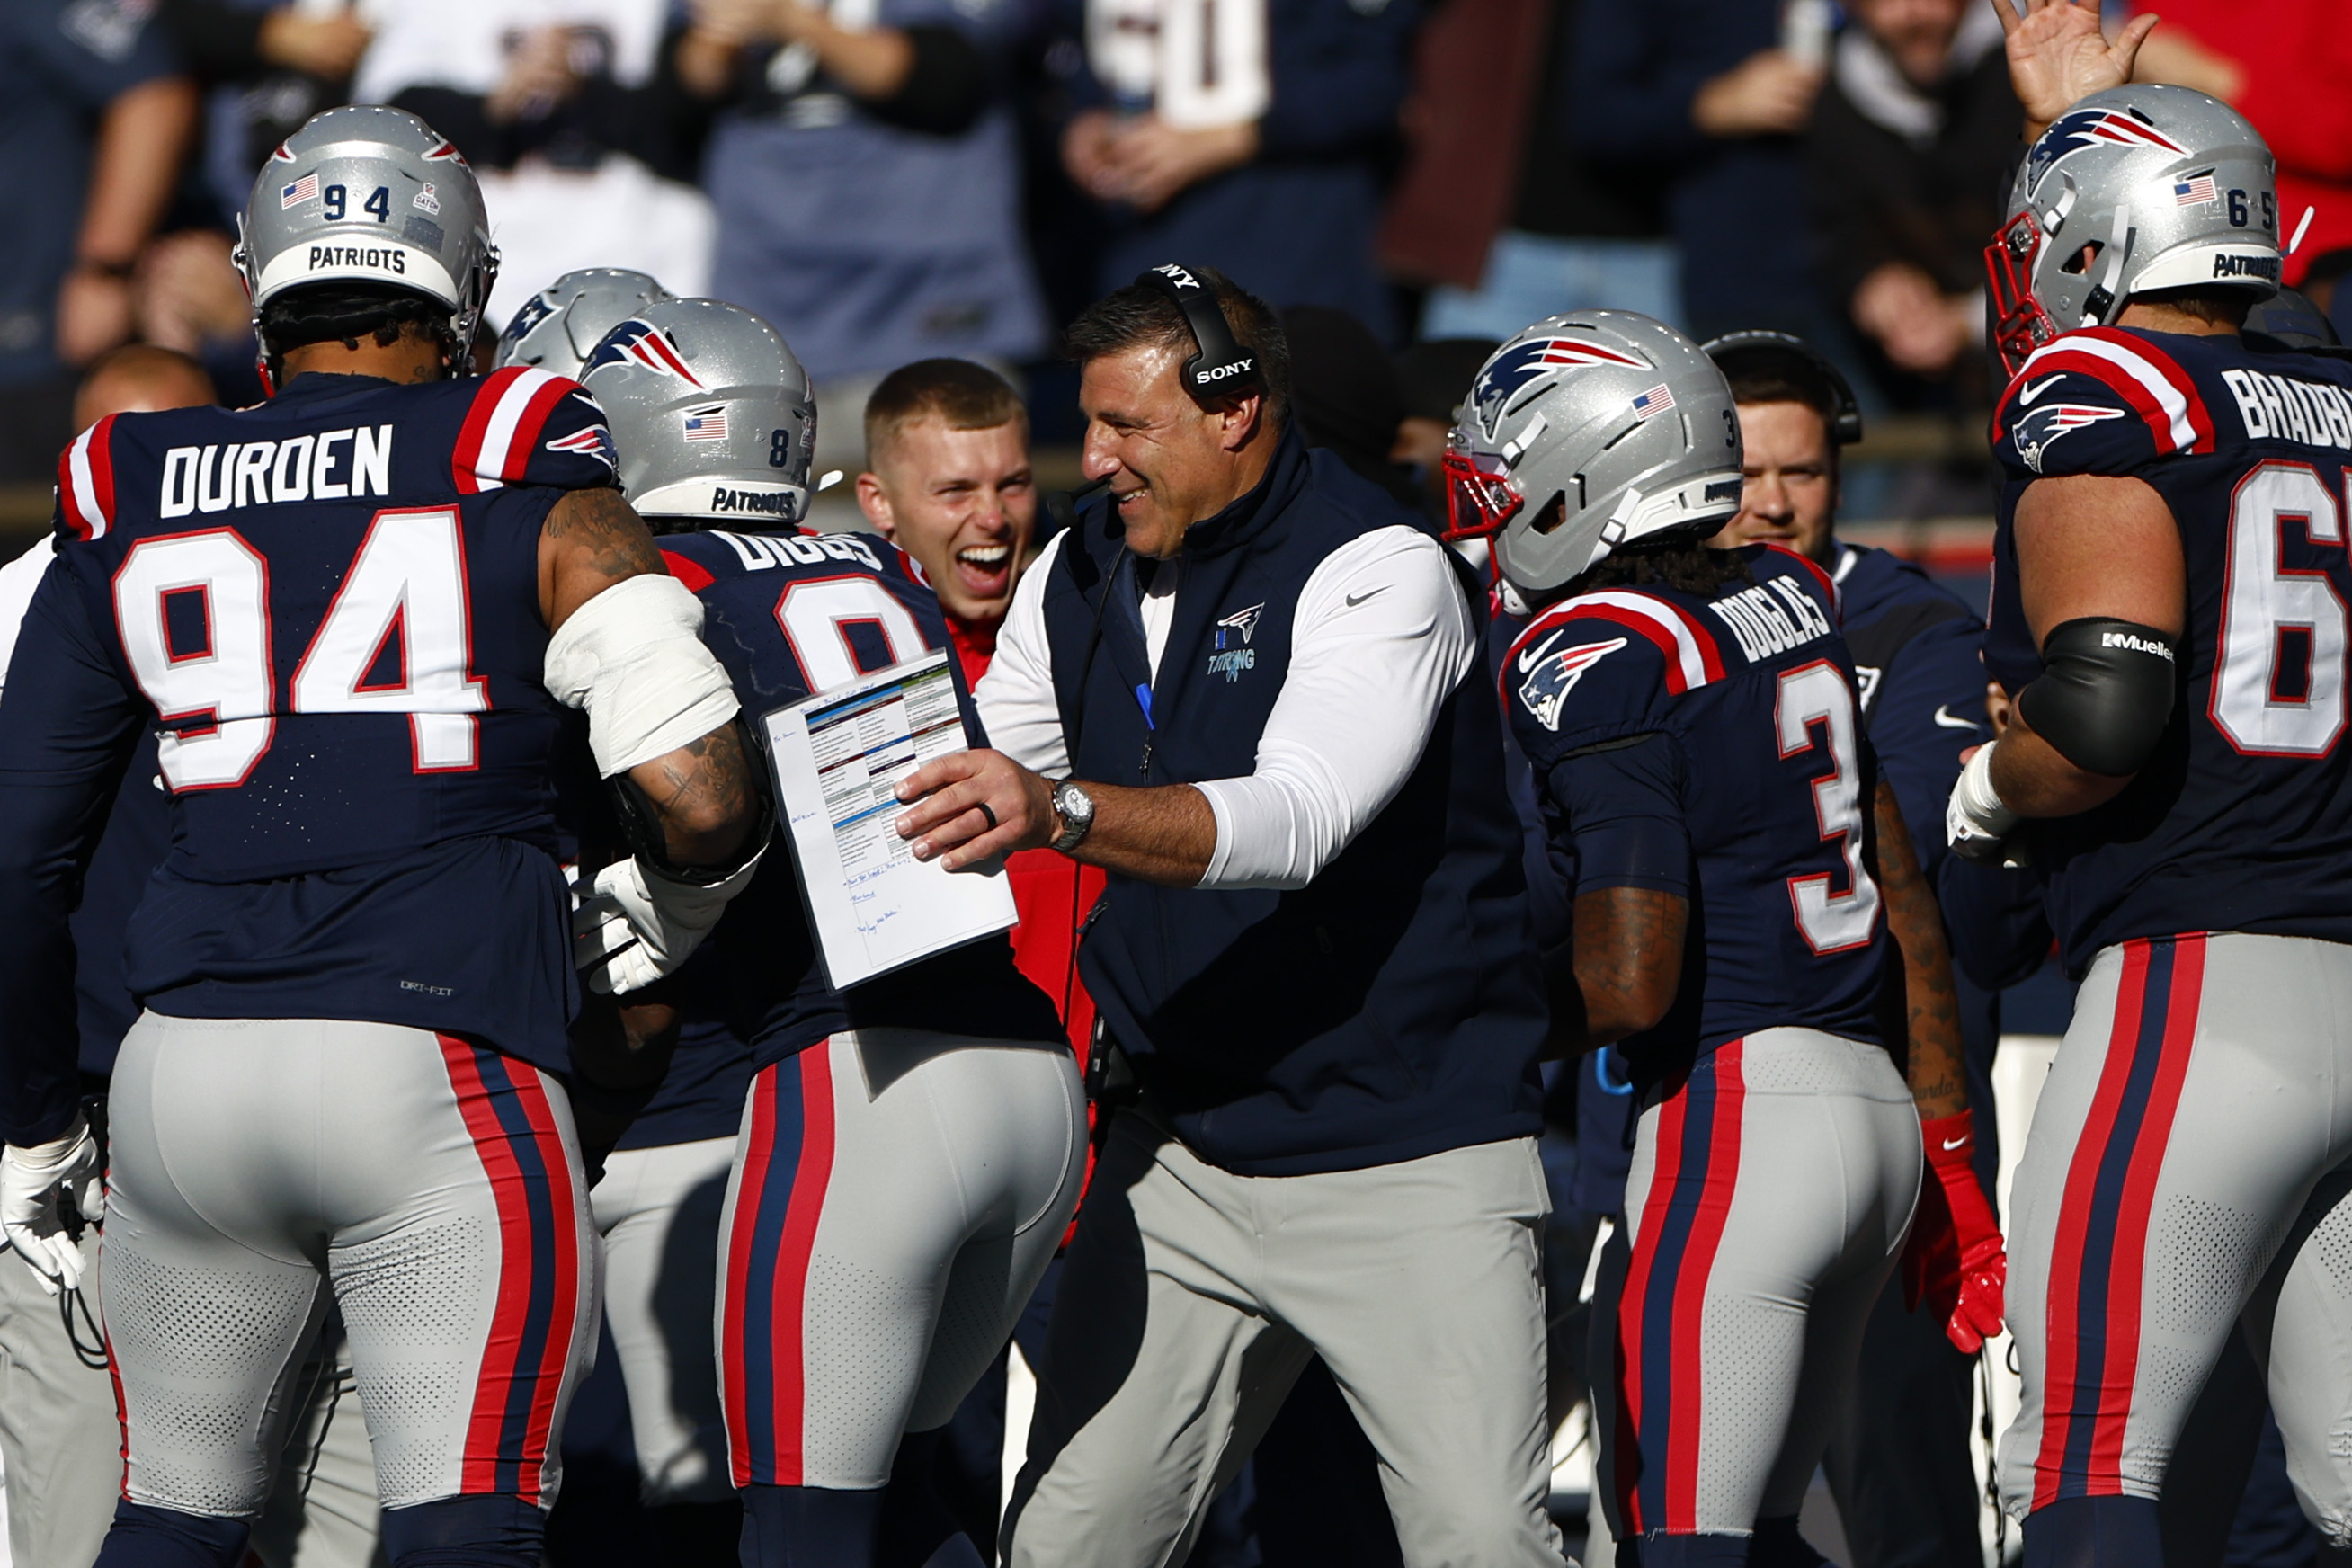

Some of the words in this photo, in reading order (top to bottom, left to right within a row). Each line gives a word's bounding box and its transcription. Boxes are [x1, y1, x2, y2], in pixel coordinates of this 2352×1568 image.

[309, 246, 405, 274] PATRIOTS
[1197, 359, 1252, 384] SONY
[769, 429, 789, 468] 8
[1722, 409, 1735, 448] 3
[160, 424, 393, 519] DURDEN
[1708, 575, 1831, 664] DOUGLAS
[2206, 459, 2352, 759] 6
[111, 503, 493, 795] 94
[1774, 657, 1882, 957] 3
[400, 980, 454, 996] DRI-FIT
